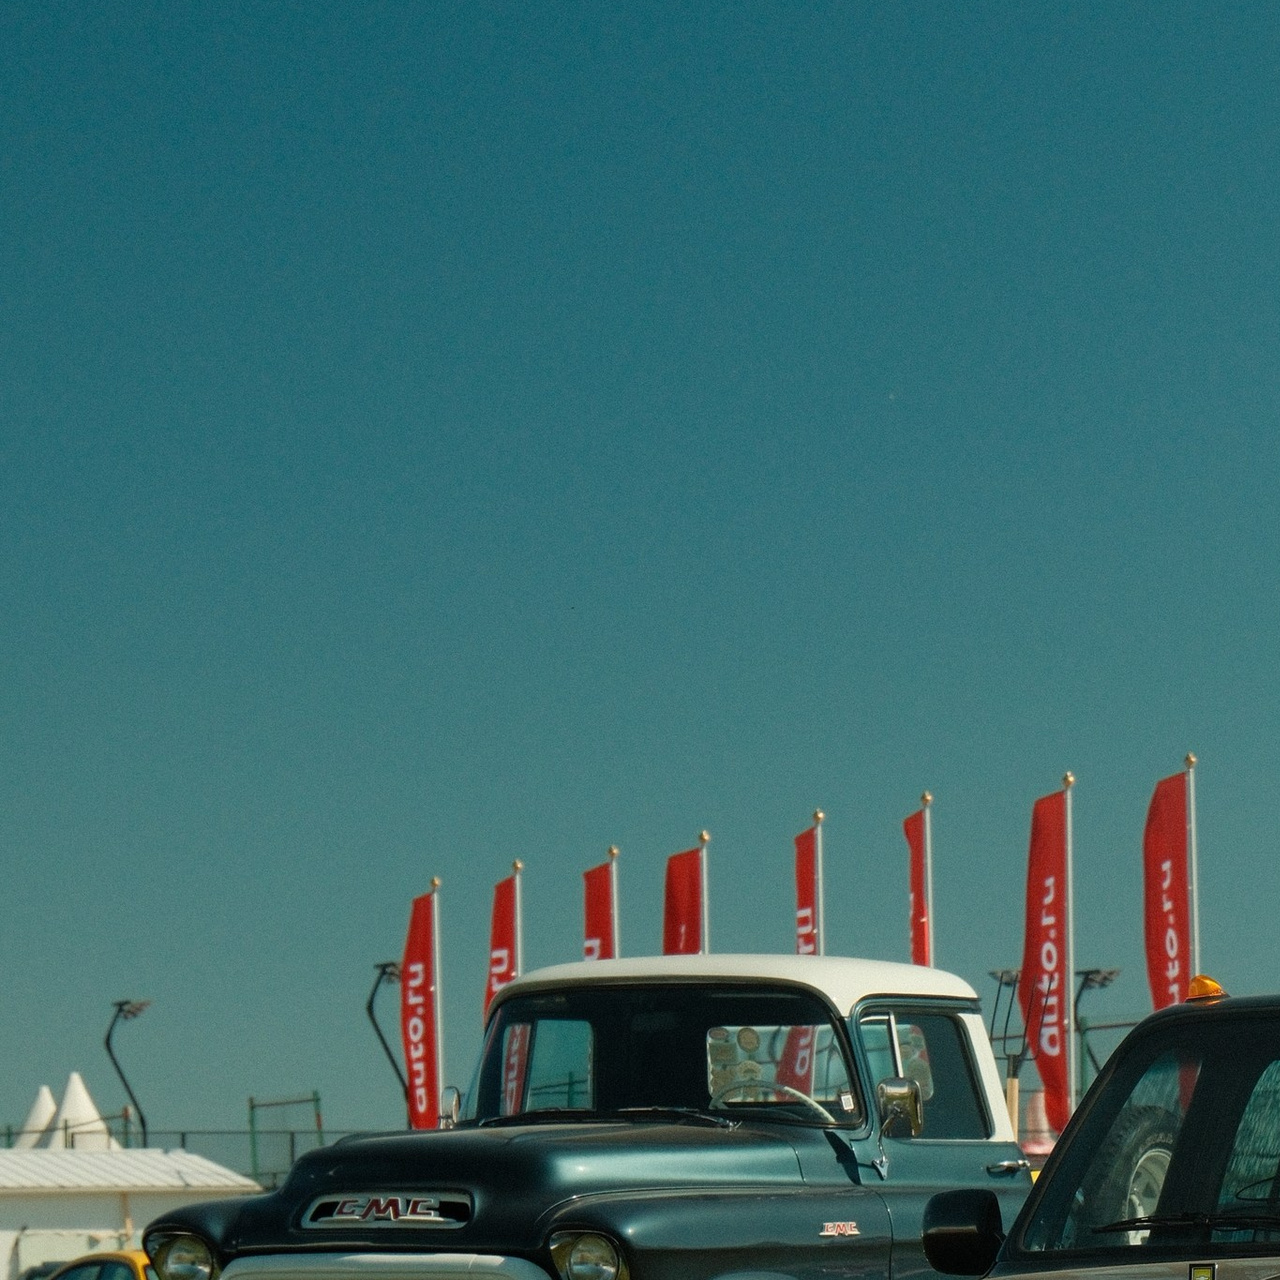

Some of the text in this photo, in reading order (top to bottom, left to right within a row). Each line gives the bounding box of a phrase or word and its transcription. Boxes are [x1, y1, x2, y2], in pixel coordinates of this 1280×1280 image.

[1036, 875, 1061, 1057] auto.ru
[1160, 860, 1180, 1006] uto.ru
[407, 962, 428, 1114] auto.ru
[332, 1196, 440, 1222] GMC
[821, 1220, 859, 1237] GMC
